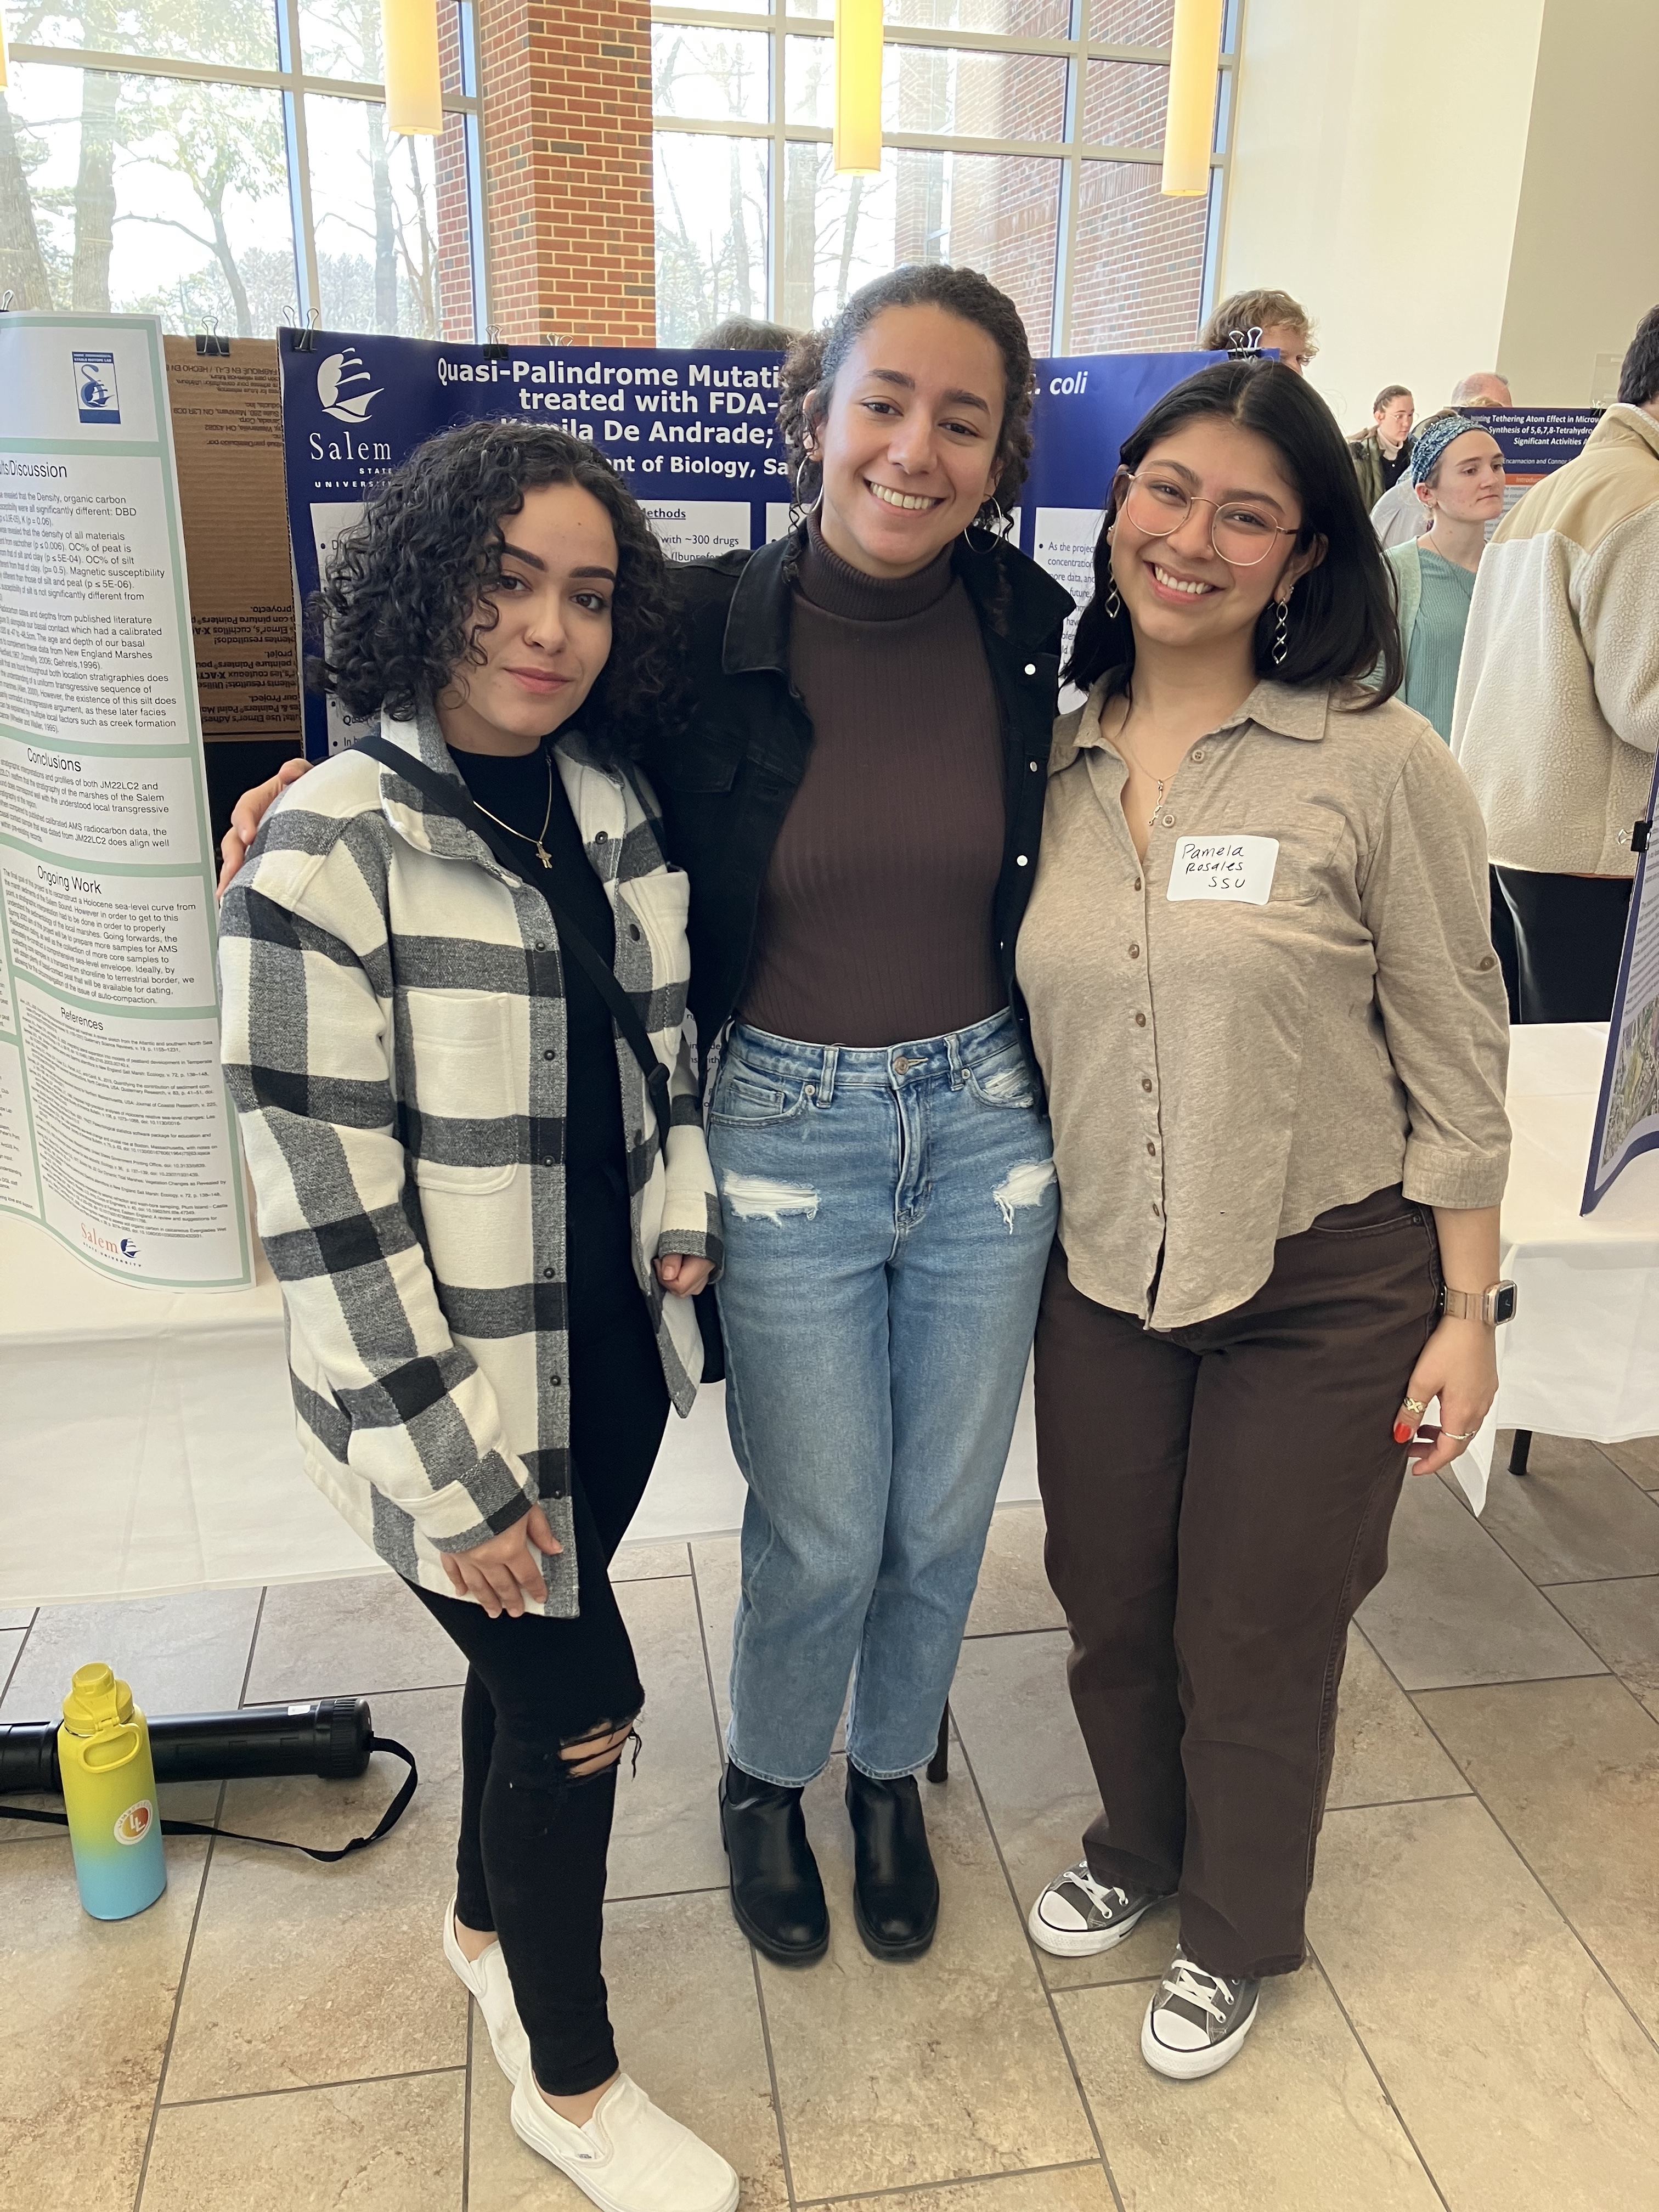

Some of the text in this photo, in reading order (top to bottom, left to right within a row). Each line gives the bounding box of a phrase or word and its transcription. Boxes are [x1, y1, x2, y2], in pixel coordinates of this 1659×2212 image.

[438, 358, 678, 386] Quasi-Palindrome
[1050, 371, 1088, 395] coli
[519, 388, 624, 411] treated
[635, 390, 697, 413] with
[1492, 415, 1525, 424] Tethering
[605, 420, 639, 441] De
[648, 421, 773, 448] Andrade;
[1488, 426, 1520, 435] Synthesis
[310, 432, 391, 460] Salem
[1514, 437, 1549, 446] Significant
[642, 456, 664, 472] of
[671, 456, 755, 478] Biology,
[64, 495, 126, 504] organic carbon
[36, 506, 73, 516] significantly
[76, 507, 112, 515] different:
[42, 529, 63, 540] density
[86, 532, 125, 540] materials
[660, 535, 738, 547] with ~300 drugs
[1048, 542, 1057, 550] As
[1060, 543, 1070, 551] the
[69, 543, 121, 554] OC% peat
[70, 567, 165, 578] Magnetic susceptibility
[1068, 572, 1082, 583] data,
[88, 591, 122, 600] different
[1070, 589, 1092, 601] future,
[251, 605, 292, 613] proyecto.
[74, 614, 151, 624] published literature
[239, 616, 271, 624] pintura
[94, 627, 109, 635] had
[73, 637, 93, 647] depth
[215, 636, 263, 645] resultados!
[64, 648, 78, 656] New
[81, 649, 112, 659] England
[264, 650, 294, 659] projet.
[255, 659, 292, 668] peinture
[62, 670, 87, 680] location
[90, 673, 144, 683] stratigraphies
[249, 694, 281, 703] Project.
[95, 707, 116, 715] these
[27, 747, 81, 772] Conclusions
[83, 779, 98, 788] both
[100, 781, 139, 789] JM22LC2
[79, 792, 109, 800] marshes
[93, 803, 168, 814] local transgressive
[69, 822, 82, 831] AMS
[84, 825, 127, 834] radiocarbon
[129, 828, 150, 836] data,
[75, 834, 106, 844] JM22LC2
[108, 838, 127, 846] does
[130, 839, 149, 848] align
[1182, 844, 1244, 859] Pamela
[1186, 861, 1243, 874] Rosales
[37, 865, 102, 894] Ongoing Work
[1209, 877, 1245, 889] SSU
[83, 899, 112, 909] Holocene
[133, 925, 165, 933] properly
[104, 932, 123, 942] Going
[126, 934, 162, 943] forwards,
[112, 945, 143, 953] samples
[127, 956, 159, 964] samples
[101, 962, 174, 975] envelope. Ideally, by
[115, 974, 149, 983] terrestrial
[103, 984, 132, 992] available
[146, 986, 173, 995] dating,
[98, 991, 159, 1005] auto-compaction.
[60, 1007, 104, 1031] References
[80, 1222, 119, 1255] Salem
